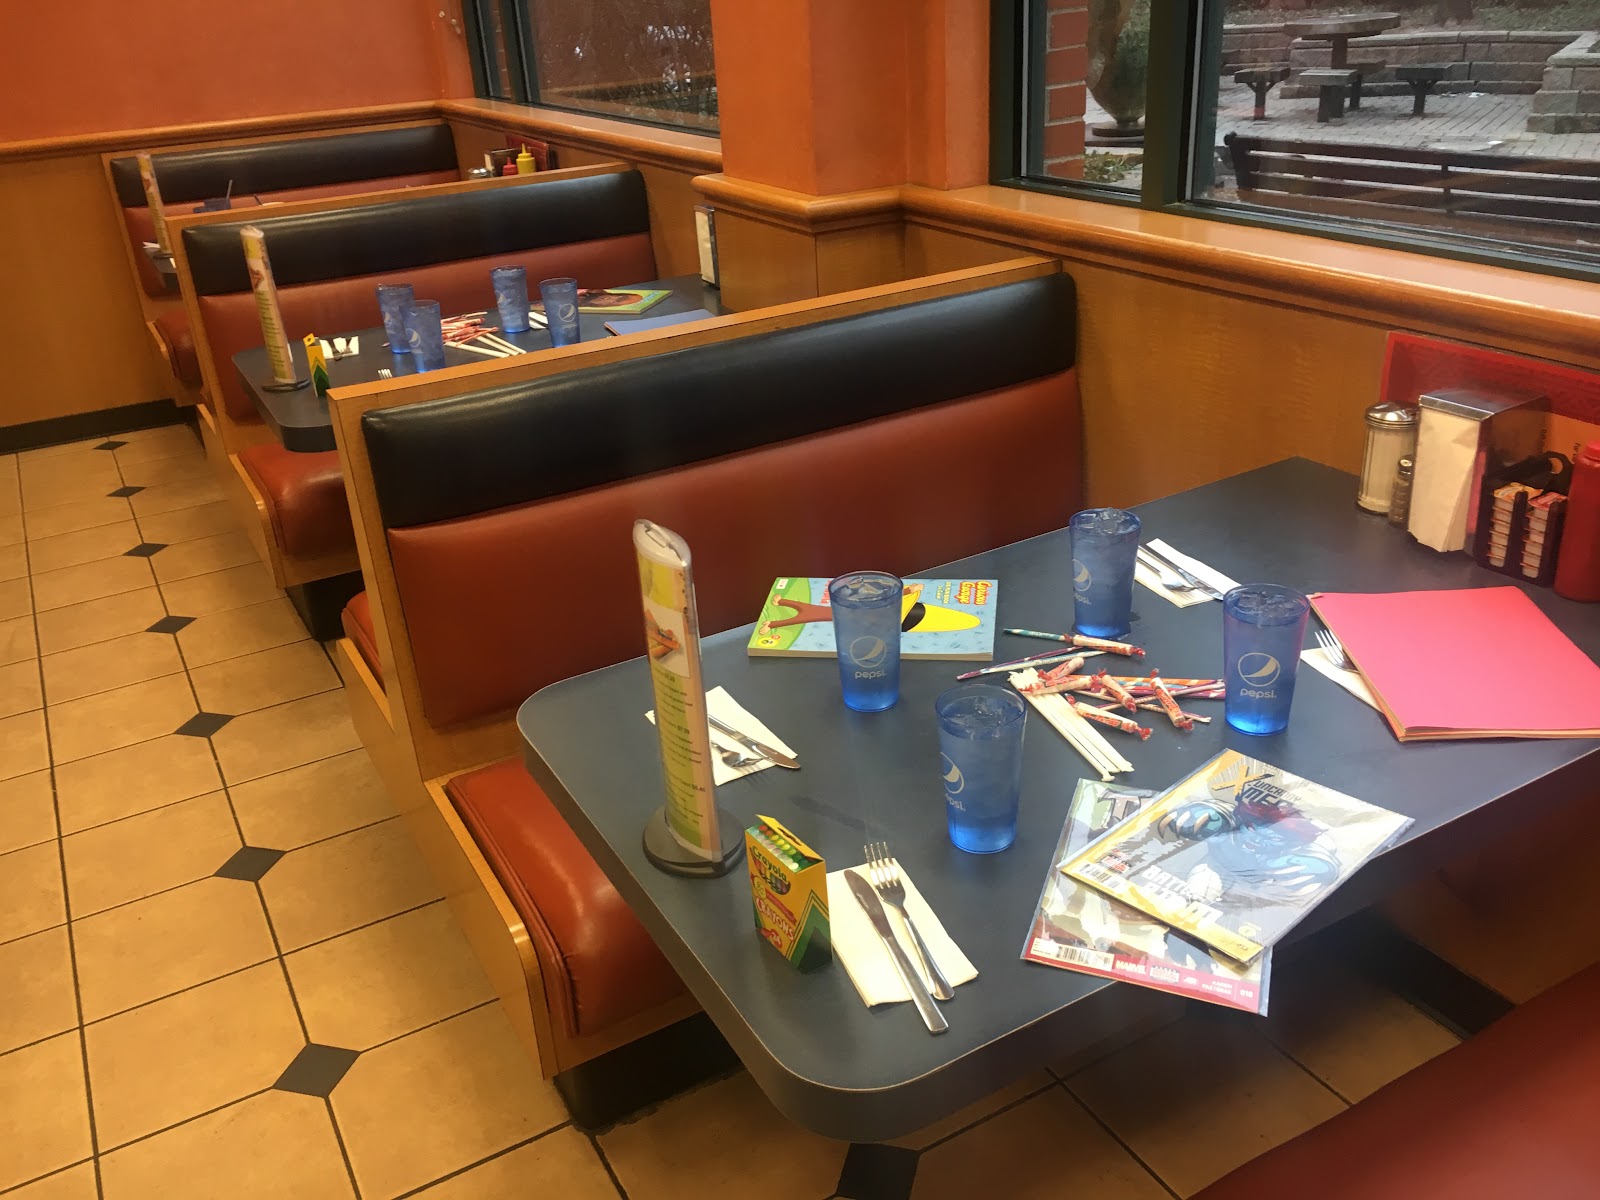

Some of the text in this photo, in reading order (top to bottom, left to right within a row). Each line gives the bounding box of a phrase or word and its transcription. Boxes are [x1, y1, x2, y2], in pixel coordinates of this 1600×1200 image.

[954, 580, 976, 604] George
[974, 580, 992, 605] Curious
[854, 669, 886, 680] pepsi
[1240, 688, 1276, 699] pepsi
[751, 845, 788, 884] Crayola
[756, 896, 796, 943] CRAYONS
[1115, 959, 1147, 975] MARVEL
